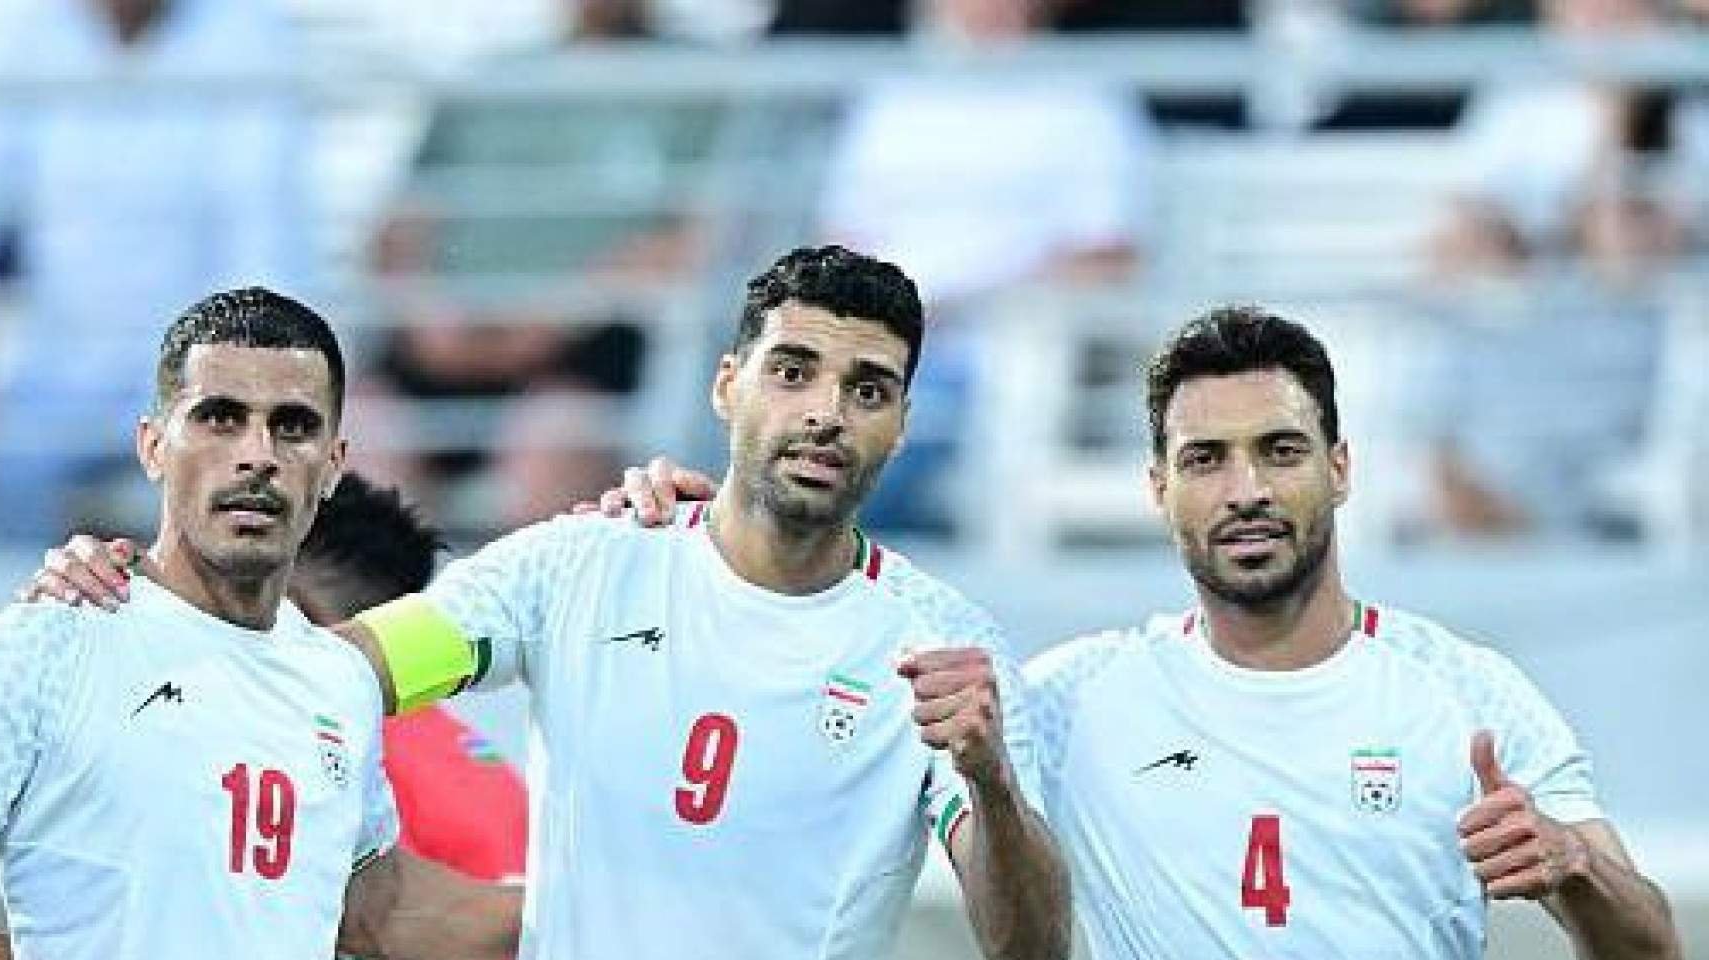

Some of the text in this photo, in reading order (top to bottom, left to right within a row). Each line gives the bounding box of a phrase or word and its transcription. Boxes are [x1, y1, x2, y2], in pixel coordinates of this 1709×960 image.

[221, 762, 297, 881] 19
[674, 711, 741, 826] 9
[1240, 814, 1292, 928] 4
